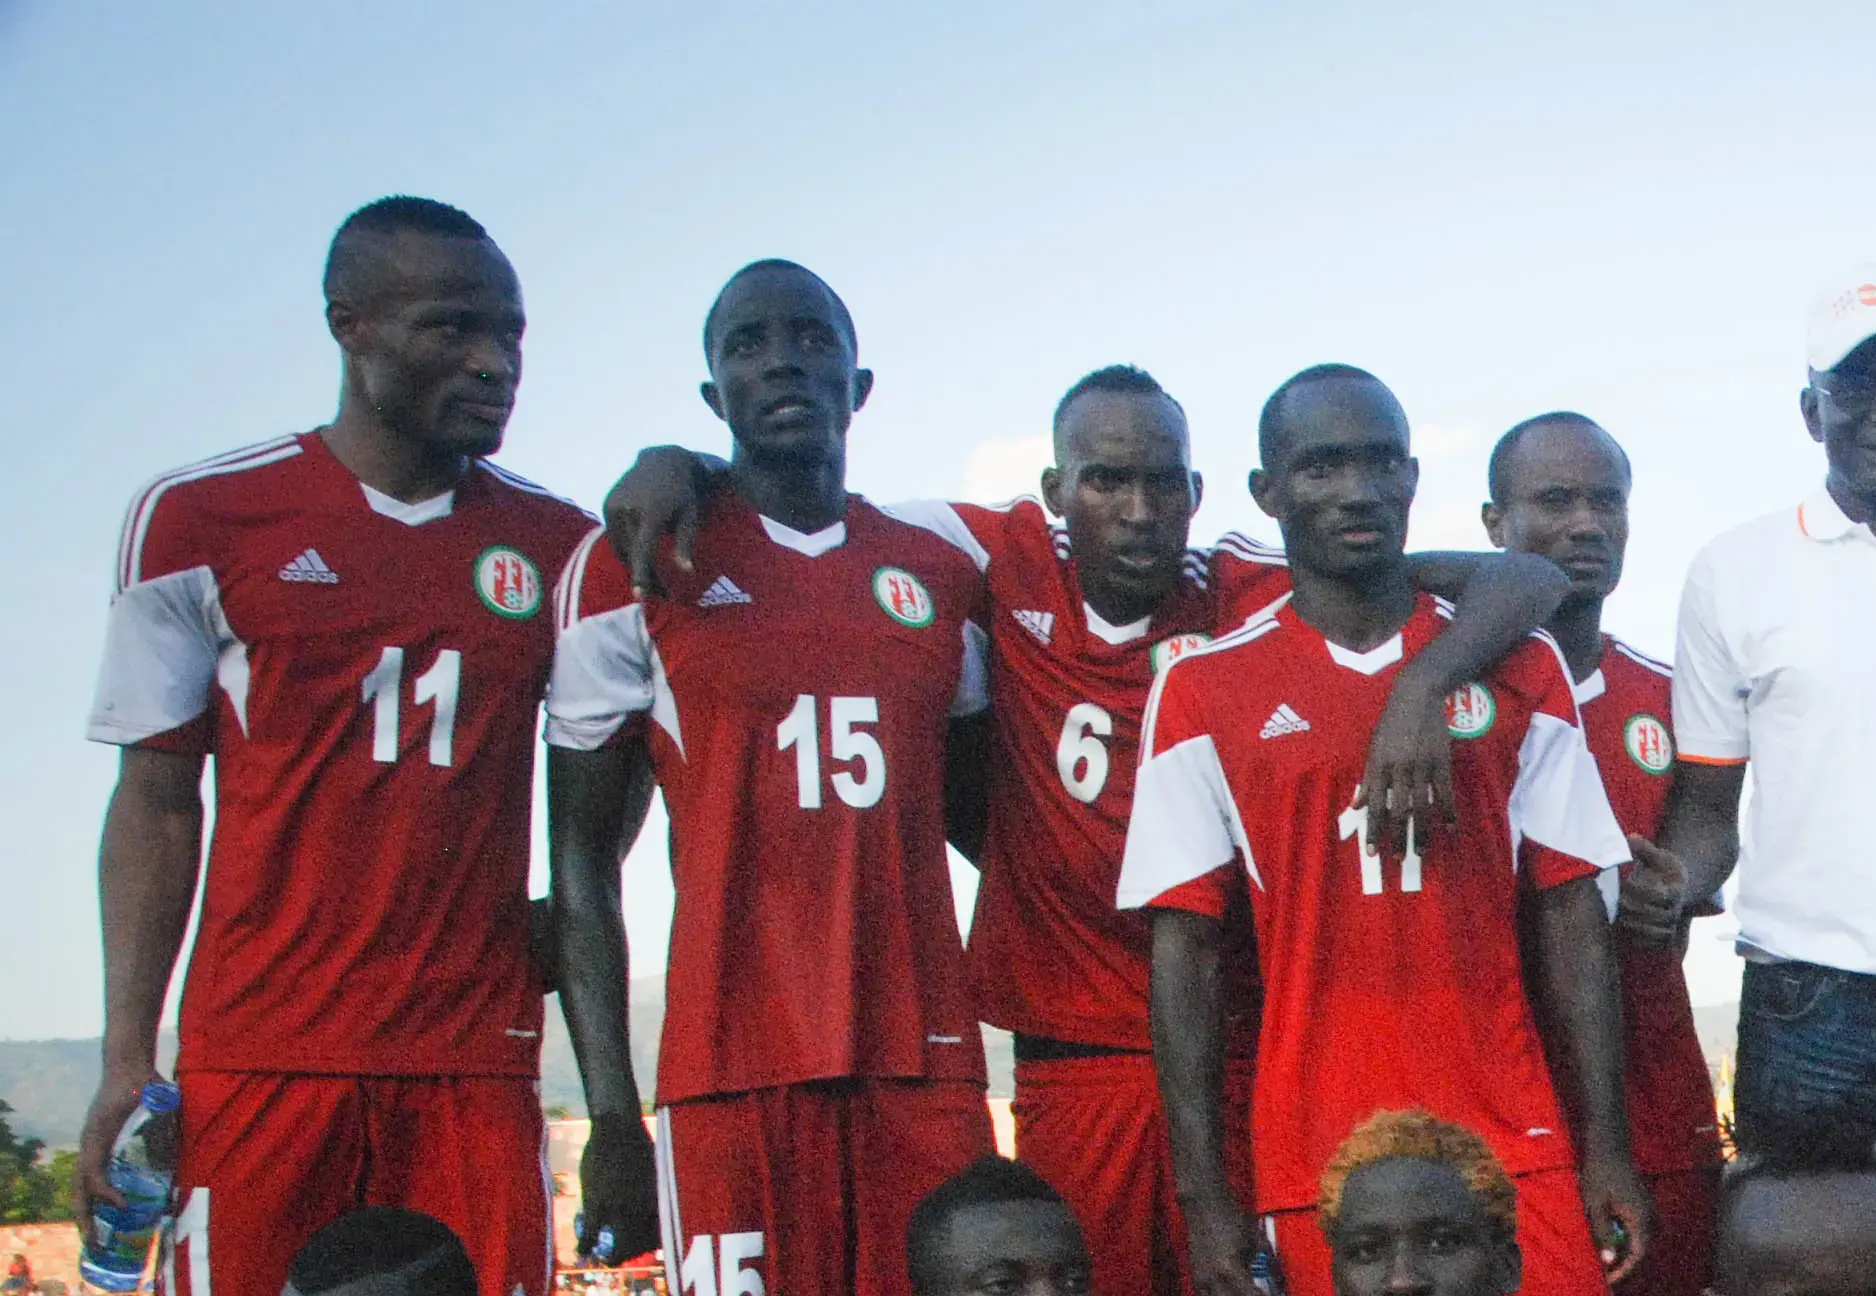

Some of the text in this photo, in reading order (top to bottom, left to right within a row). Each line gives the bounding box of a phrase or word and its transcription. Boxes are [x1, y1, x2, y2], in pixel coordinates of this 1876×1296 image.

[279, 569, 339, 584] adidas
[362, 646, 461, 768] 11
[776, 693, 887, 810] 15
[1056, 702, 1113, 804] 6
[1259, 719, 1311, 740] adidas
